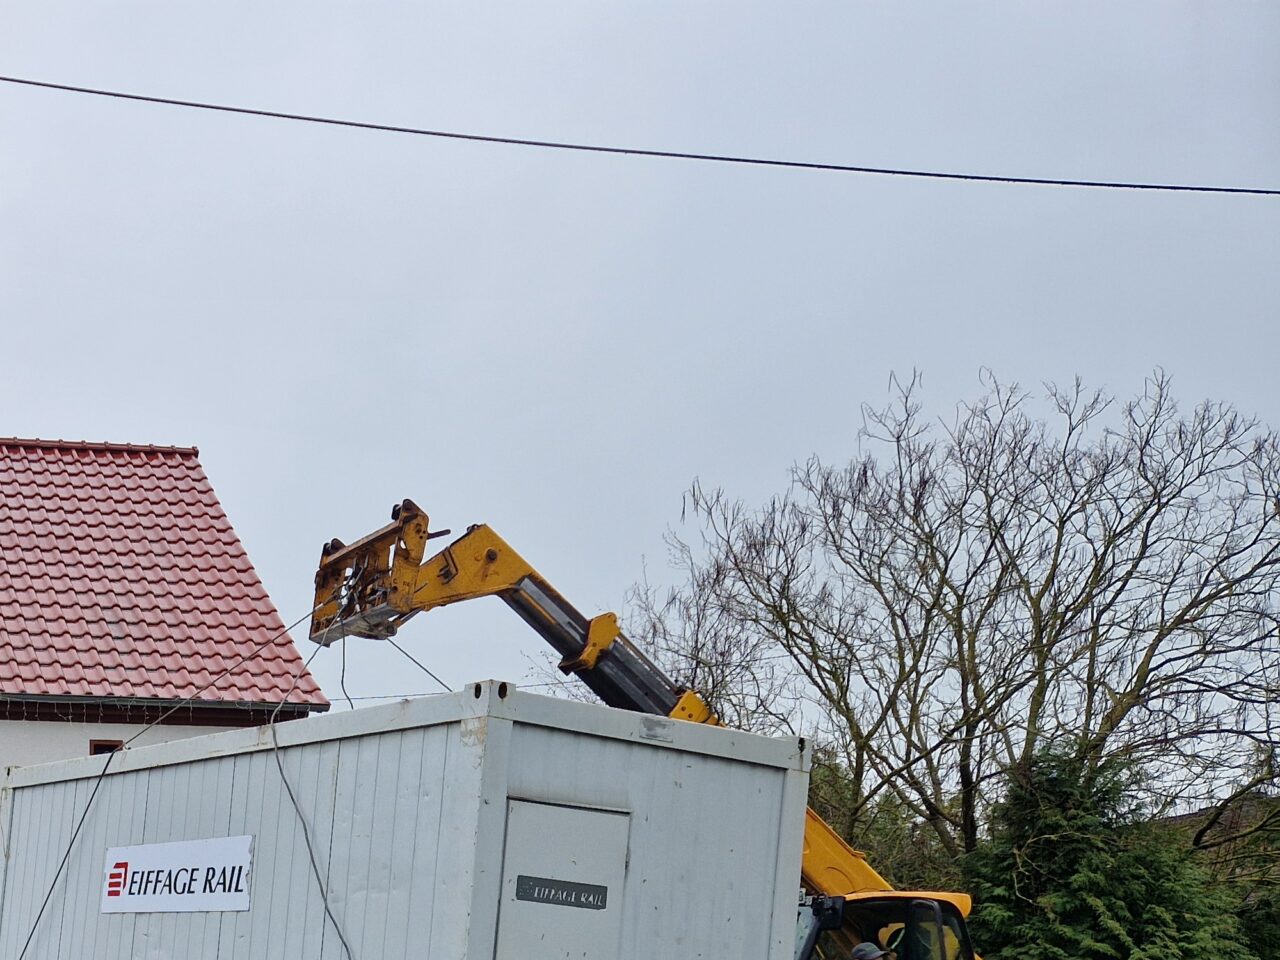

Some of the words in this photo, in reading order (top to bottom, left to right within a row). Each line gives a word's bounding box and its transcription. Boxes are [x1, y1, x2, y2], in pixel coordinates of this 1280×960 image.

[128, 867, 199, 896] EIFFAGE
[202, 865, 244, 894] RAIL
[580, 892, 603, 906] RAIL
